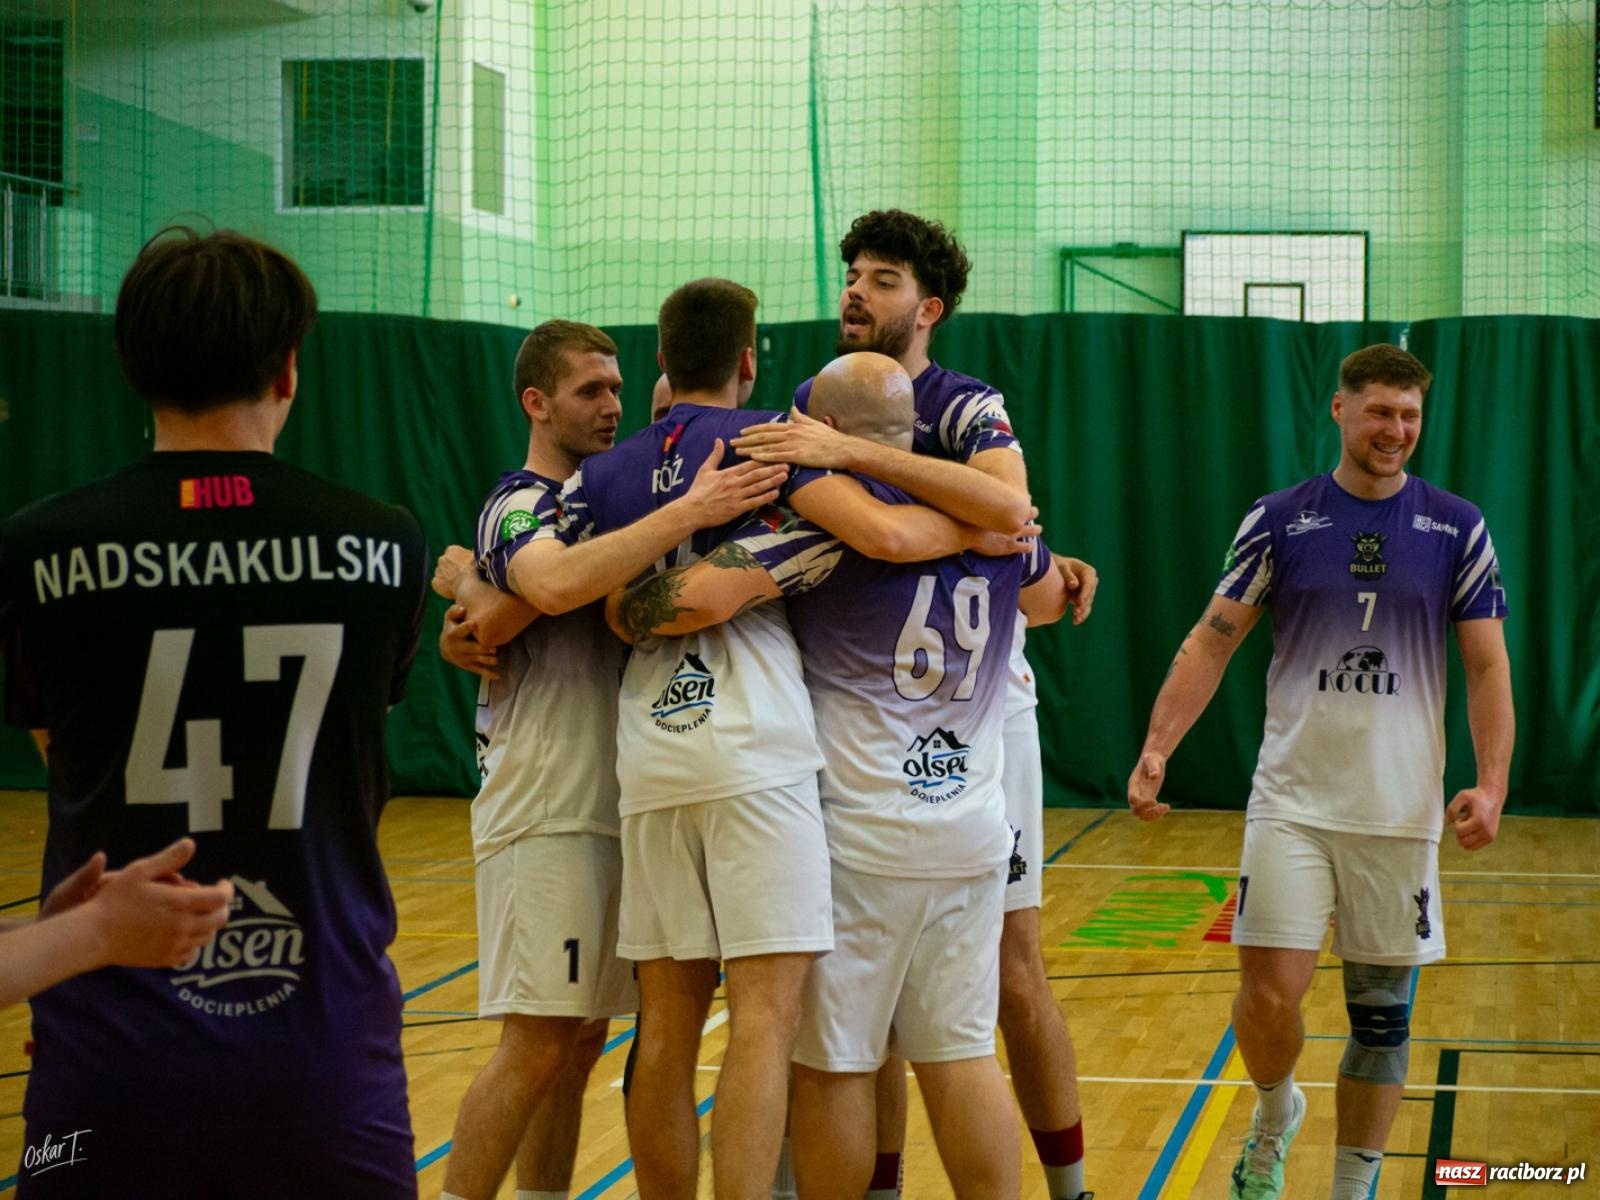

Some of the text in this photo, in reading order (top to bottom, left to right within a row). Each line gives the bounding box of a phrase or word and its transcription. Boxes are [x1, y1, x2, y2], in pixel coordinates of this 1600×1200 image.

[193, 475, 255, 508] HUB
[34, 535, 401, 604] NADSKAKULSKI
[1350, 563, 1387, 574] BULLET
[1358, 592, 1377, 632] 7
[892, 574, 991, 702] 69
[1318, 669, 1402, 697] KOCUR
[125, 623, 344, 832] 47
[910, 784, 967, 804] DOIEPLENIA
[563, 937, 580, 984] 1
[178, 983, 296, 1016] DOCIEPLENIA
